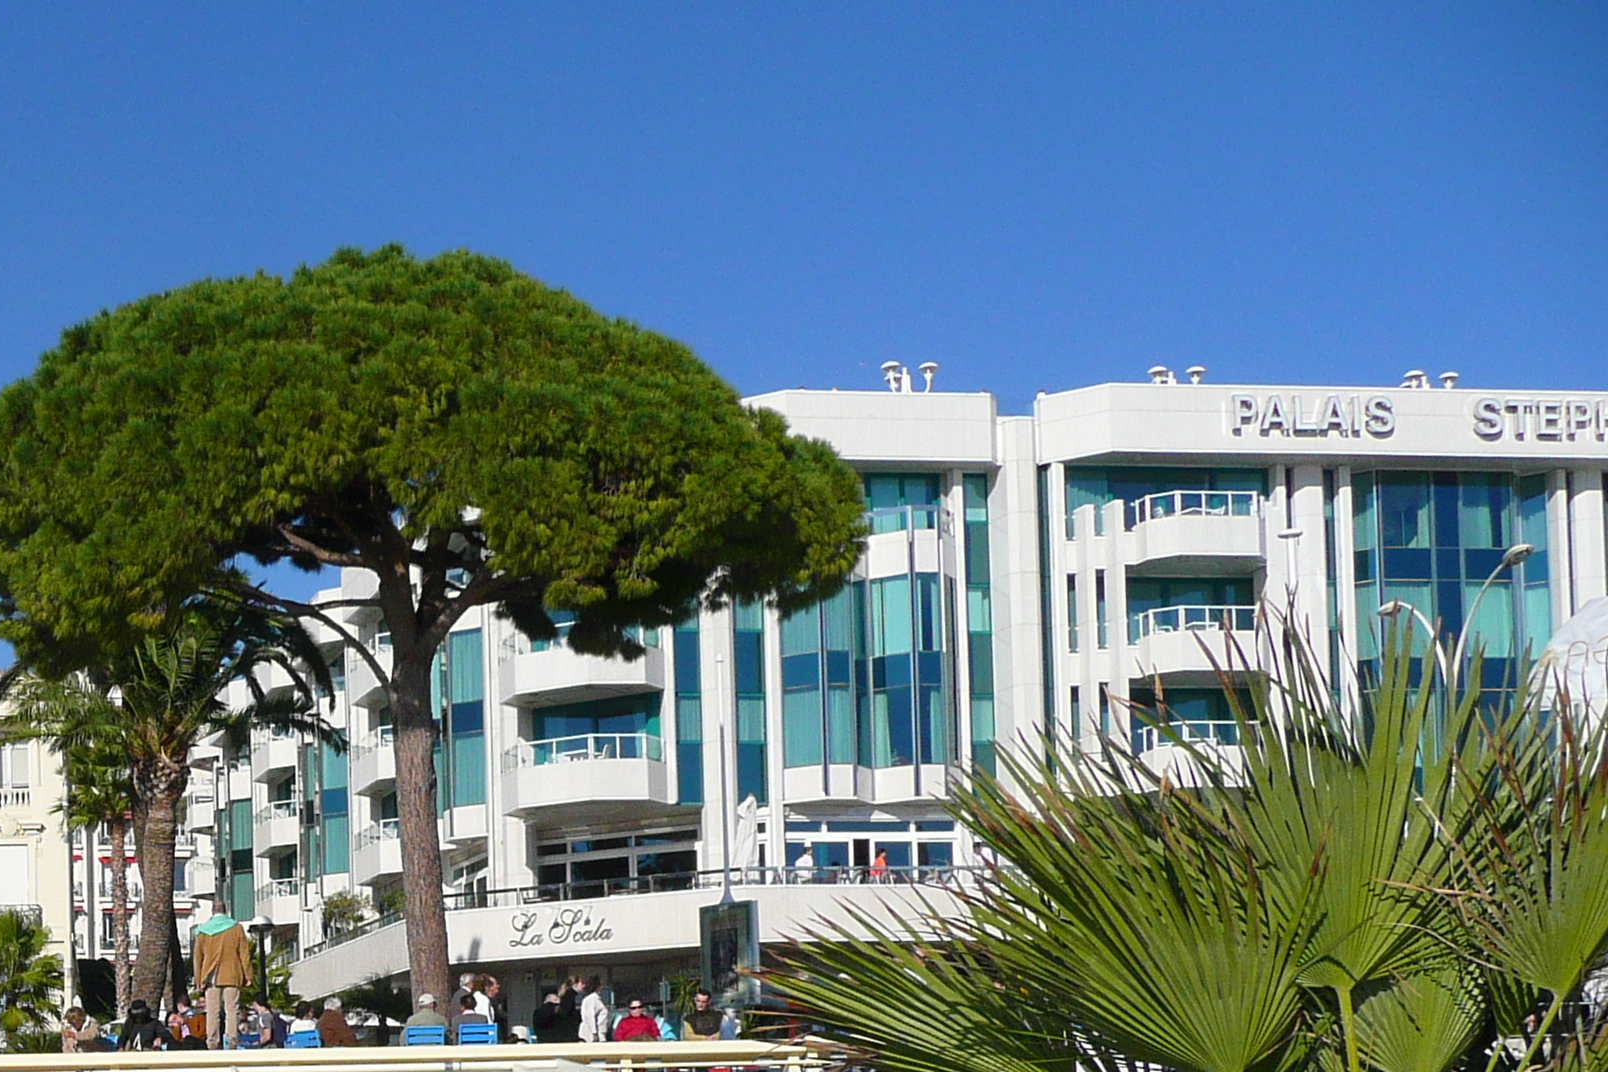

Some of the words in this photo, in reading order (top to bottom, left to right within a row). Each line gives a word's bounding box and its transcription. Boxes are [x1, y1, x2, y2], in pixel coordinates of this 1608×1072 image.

[1230, 393, 1396, 438] PALAIS
[509, 913, 544, 947] La
[548, 909, 613, 944] Scala
